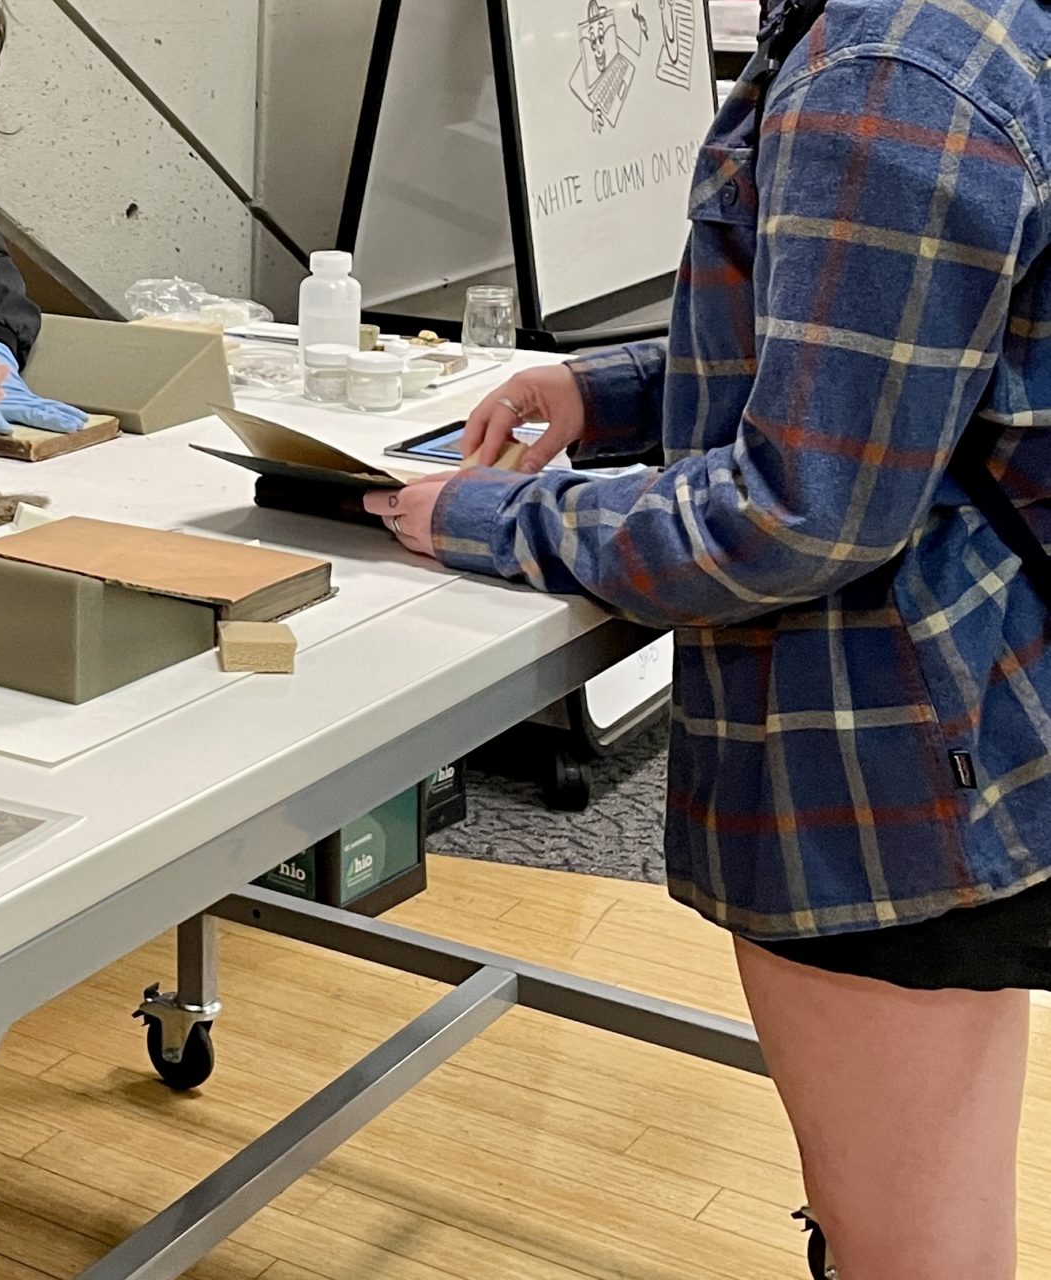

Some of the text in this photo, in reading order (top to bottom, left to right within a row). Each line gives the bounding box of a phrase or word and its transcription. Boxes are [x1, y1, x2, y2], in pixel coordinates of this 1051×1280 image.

[532, 140, 700, 219] WHITE COLUMN ON RIG
